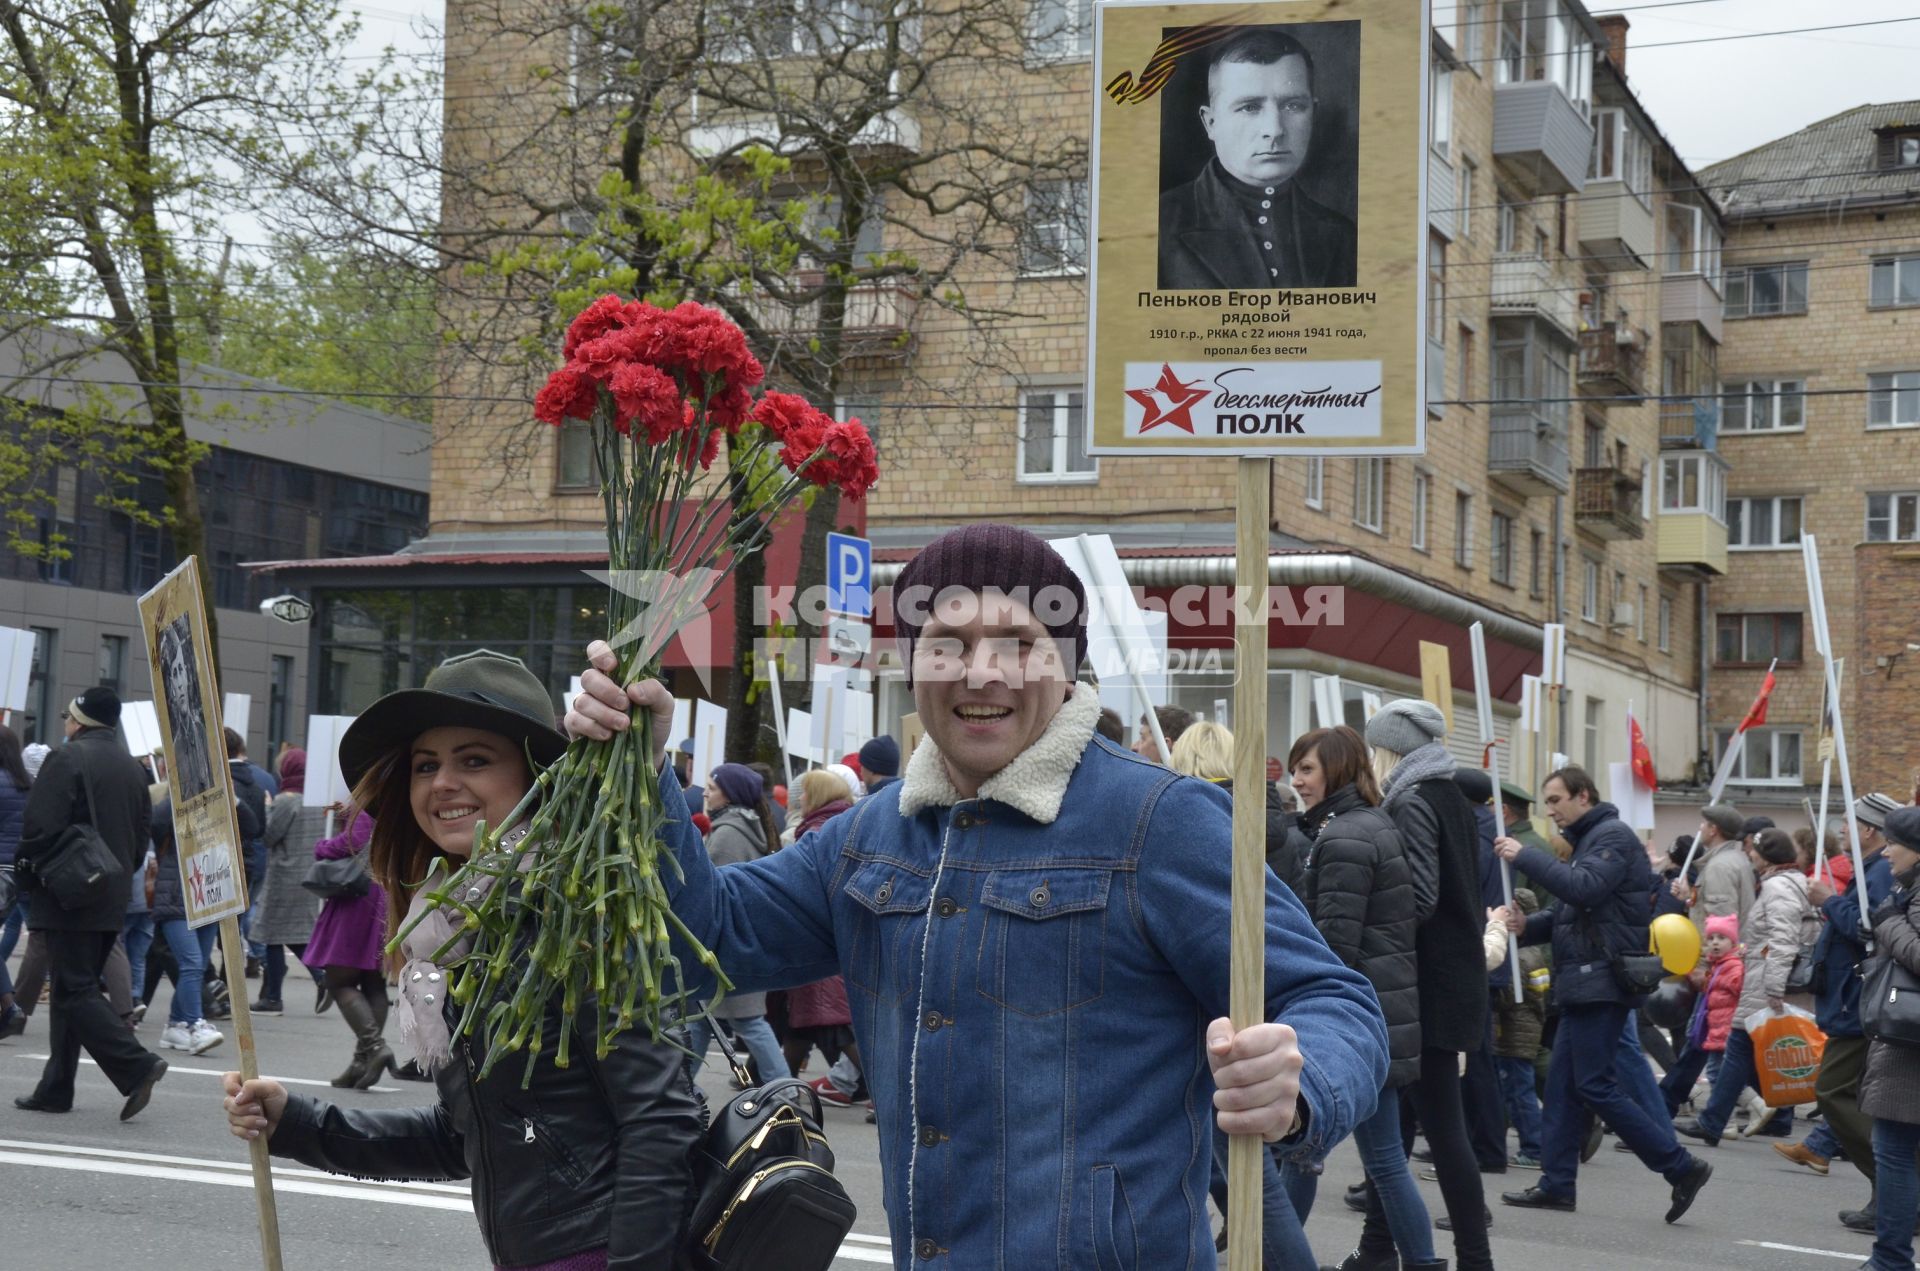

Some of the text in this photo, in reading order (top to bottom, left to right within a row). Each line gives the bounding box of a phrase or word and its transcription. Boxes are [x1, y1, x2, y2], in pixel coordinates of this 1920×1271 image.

[1138, 290, 1377, 309] Пеньков Егор Иванович
[1221, 309, 1291, 326] рядовой
[1149, 329, 1178, 339] 1910
[1180, 331, 1204, 341] г.р.,
[1207, 329, 1239, 339] РККА
[1250, 329, 1265, 338] 22
[1267, 329, 1301, 338] июня
[1304, 328, 1332, 338] 1941
[1335, 328, 1367, 339] года,
[1203, 345, 1308, 357] пропал без вести
[1213, 367, 1382, 414] бессмертный
[1216, 413, 1306, 435] ПОЛК
